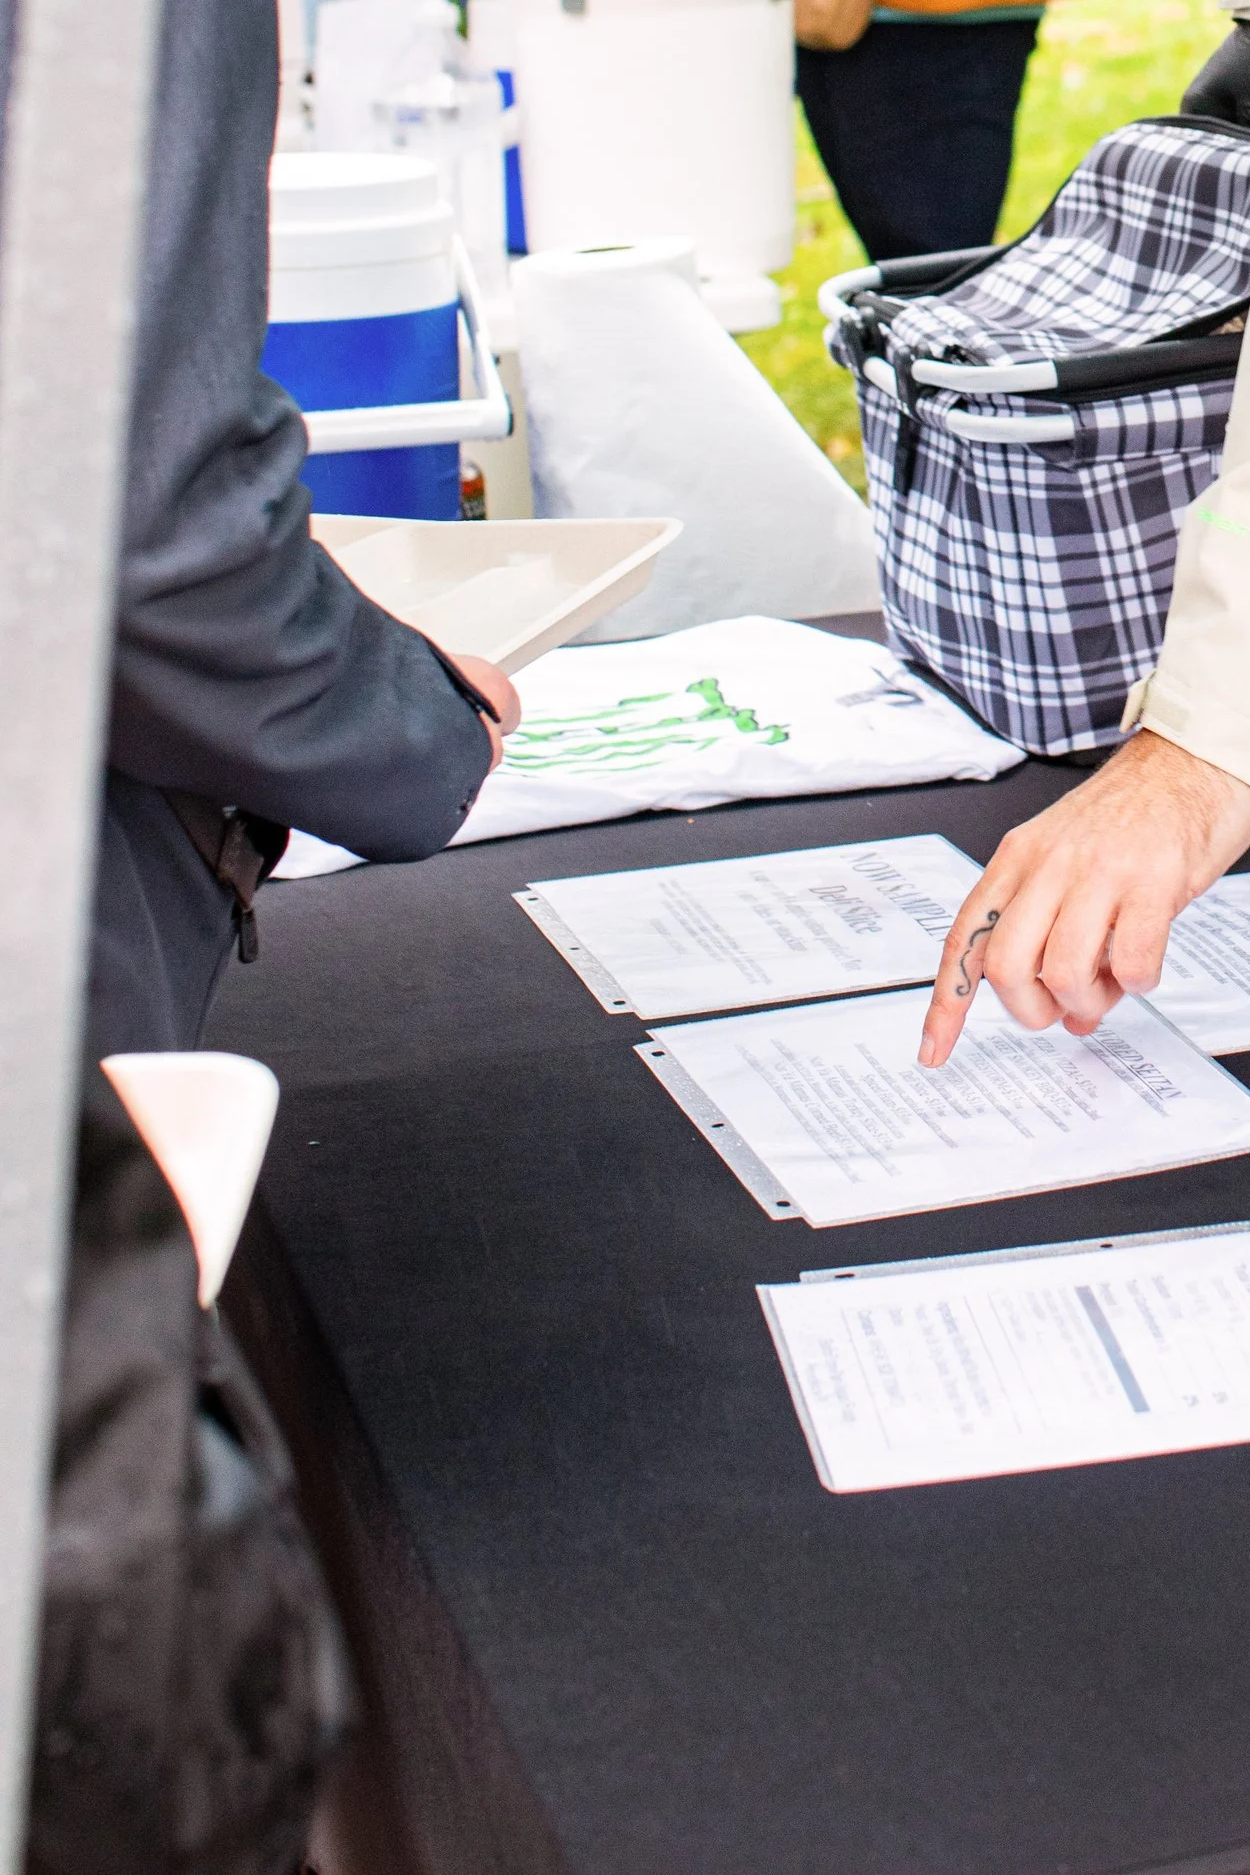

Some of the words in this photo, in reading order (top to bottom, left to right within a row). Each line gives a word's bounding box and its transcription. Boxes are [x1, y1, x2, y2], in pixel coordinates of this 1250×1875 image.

[807, 884, 865, 907] Deli
[837, 851, 908, 884] NOW
[873, 883, 960, 942] SAMPLI
[832, 905, 895, 935] Slice
[1127, 1061, 1189, 1100] SEITAN
